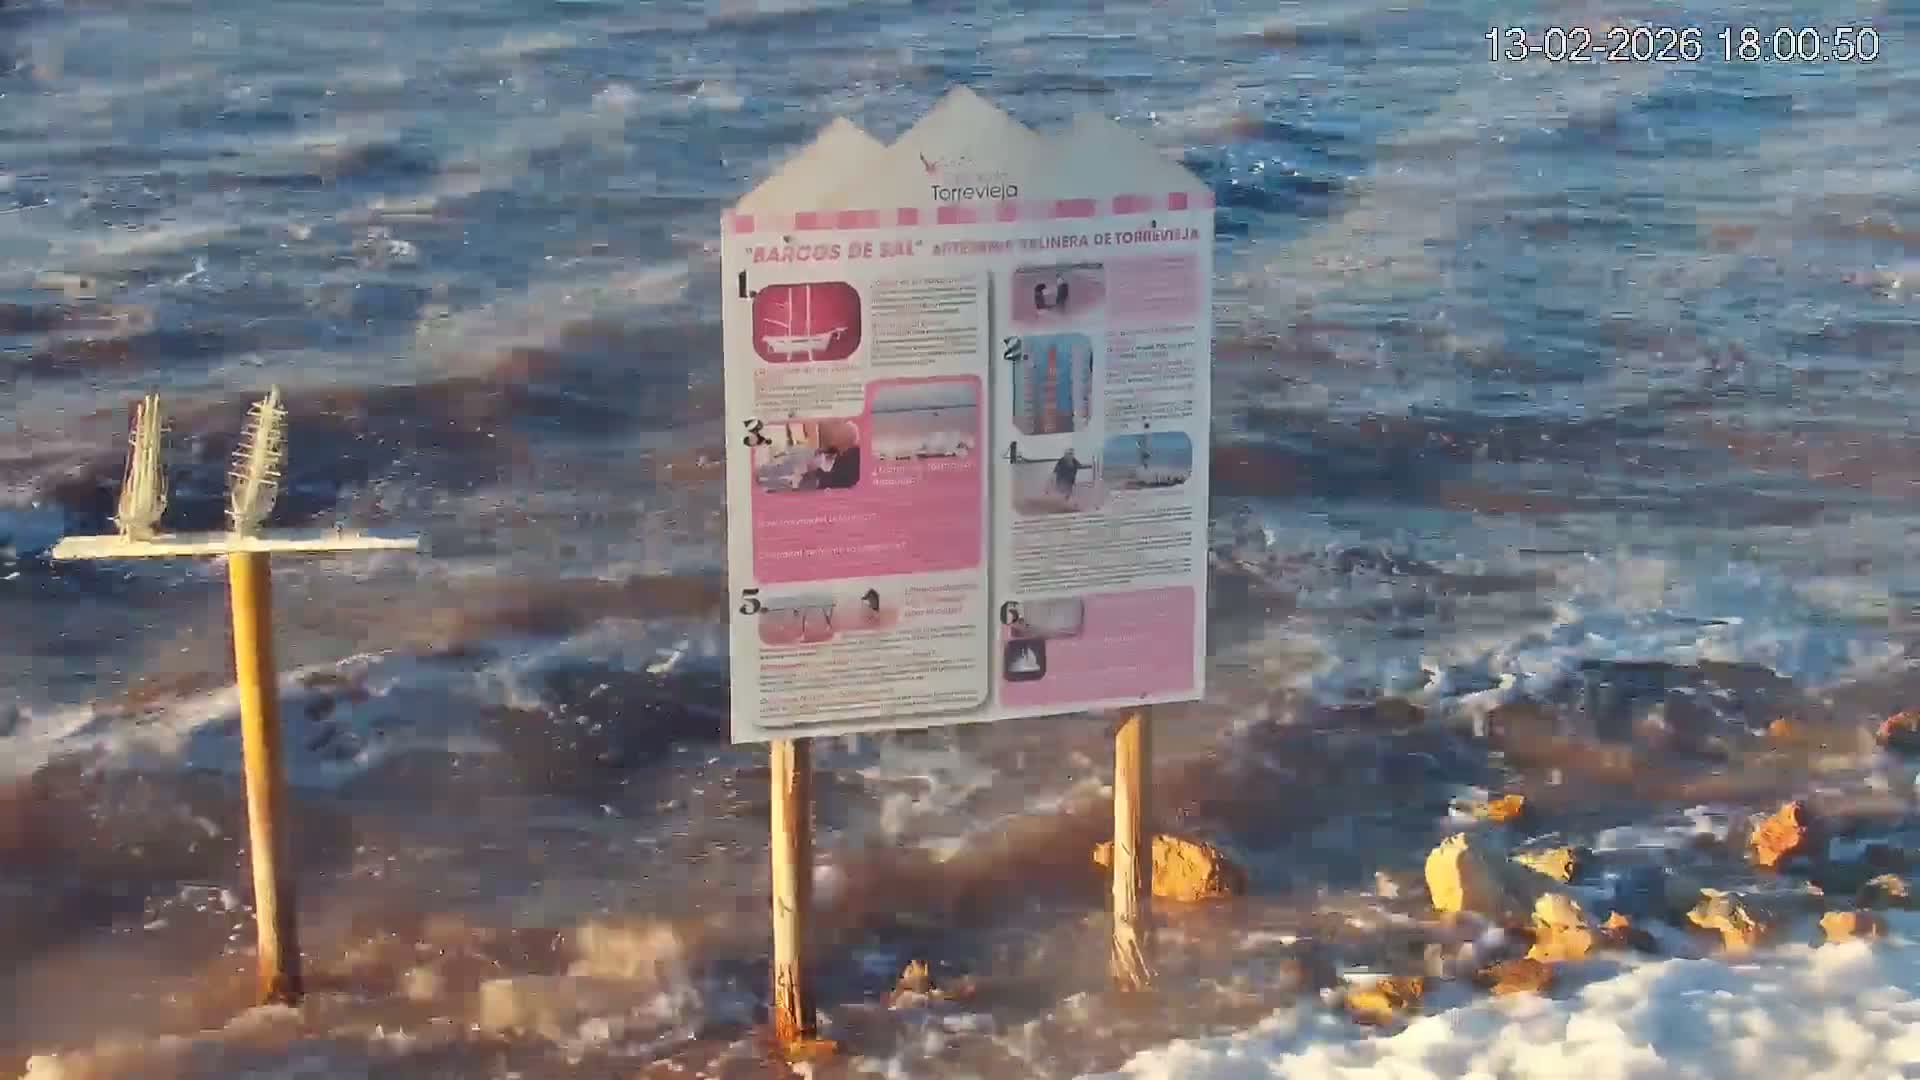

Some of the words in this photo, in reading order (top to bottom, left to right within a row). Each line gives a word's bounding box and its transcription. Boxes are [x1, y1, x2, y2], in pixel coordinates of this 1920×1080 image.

[931, 184, 1018, 201] Torrevieja
[848, 241, 873, 258] DE
[1094, 232, 1112, 246] DE
